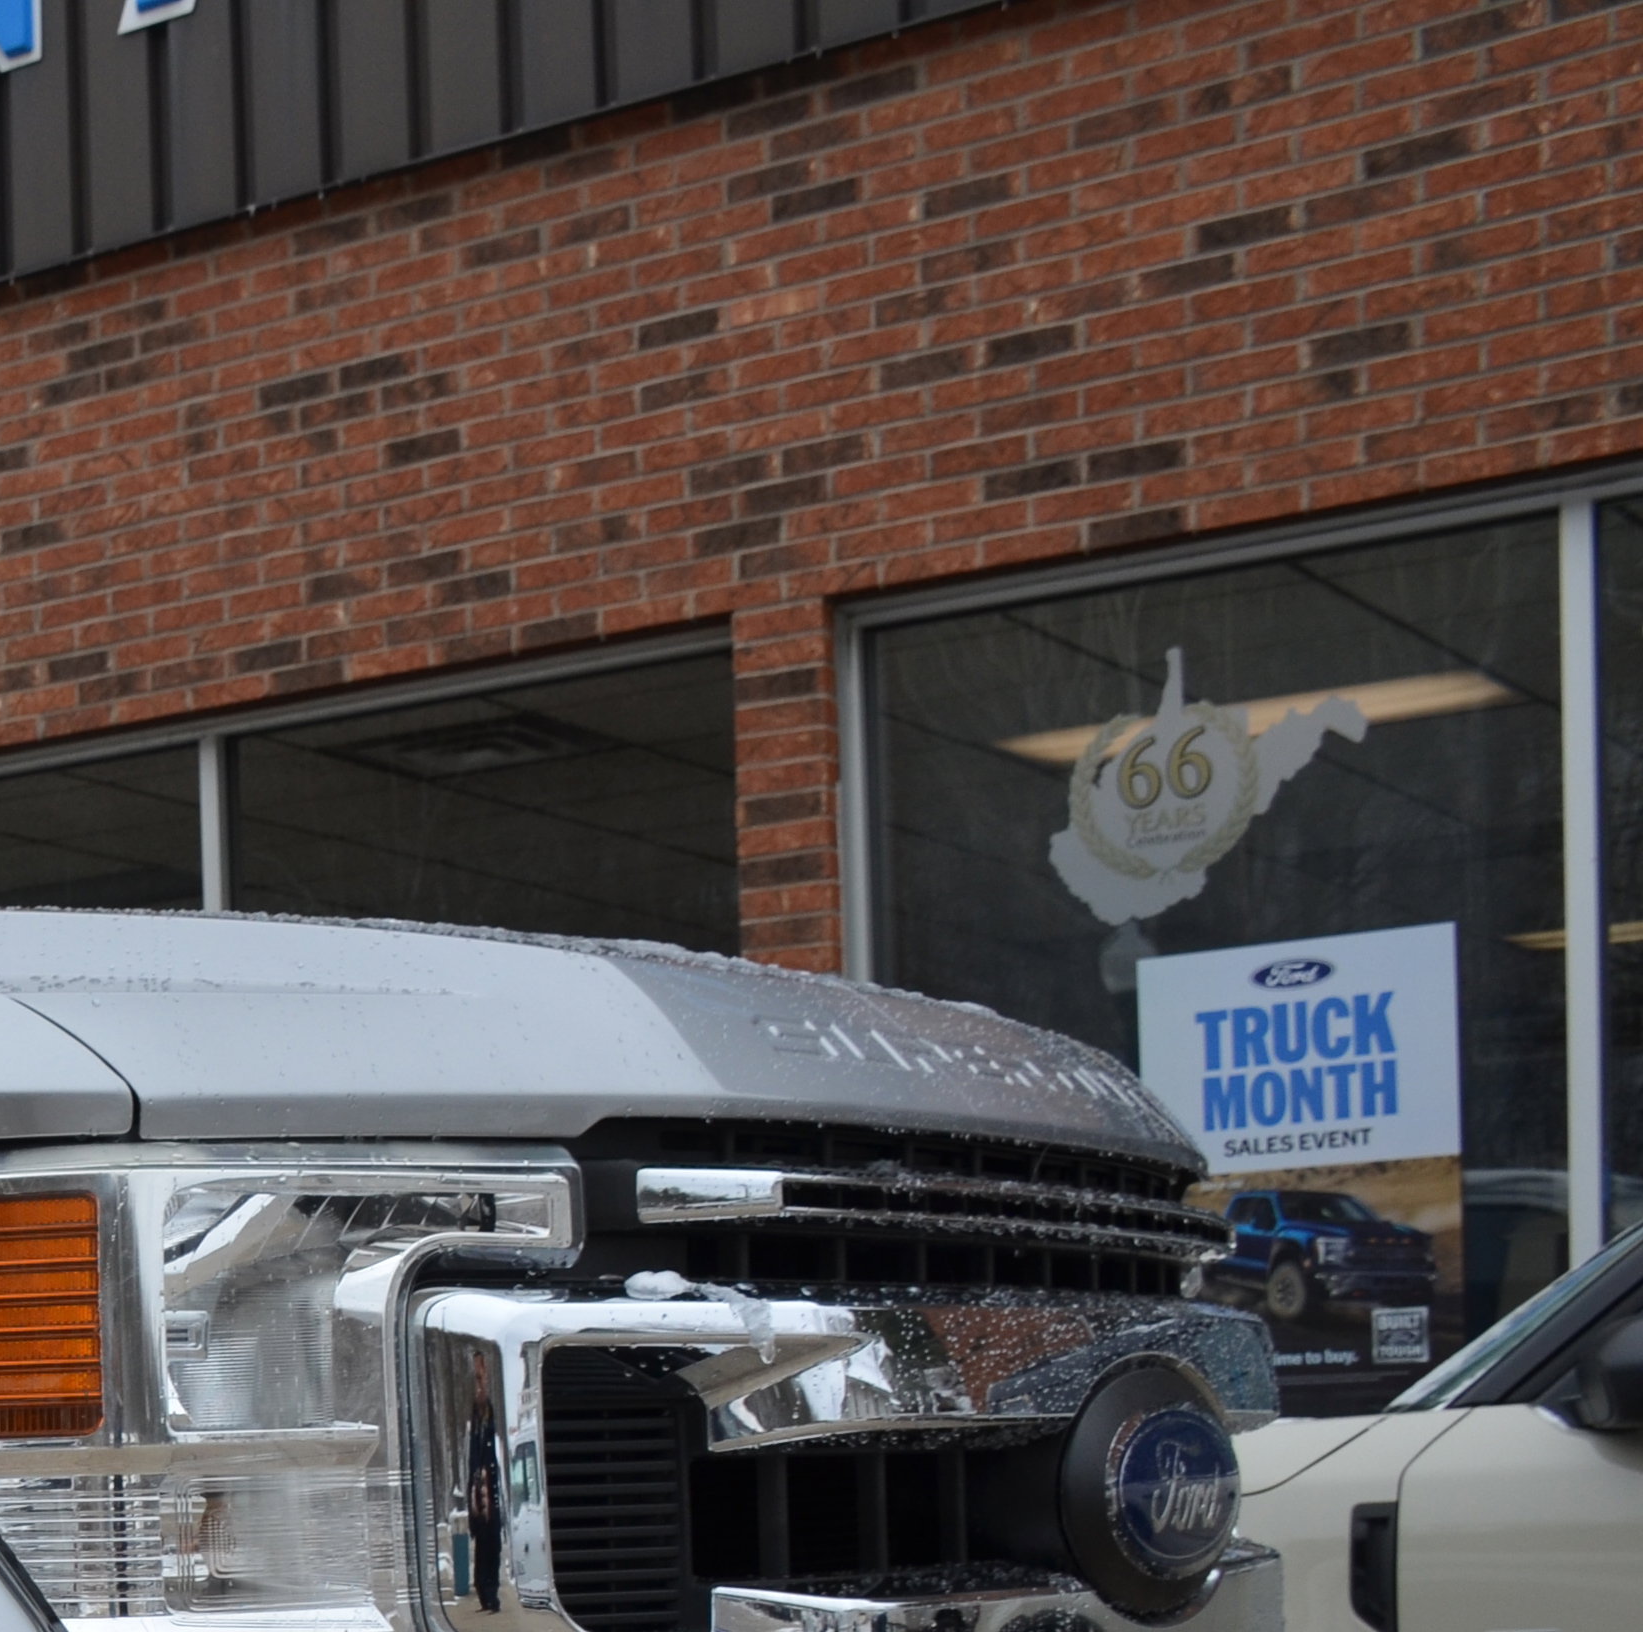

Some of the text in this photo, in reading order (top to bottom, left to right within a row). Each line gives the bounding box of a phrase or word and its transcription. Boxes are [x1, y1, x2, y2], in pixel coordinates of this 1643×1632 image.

[1117, 724, 1213, 810] 66
[1124, 803, 1207, 837] YEARS
[1266, 960, 1319, 988] Ford
[1195, 990, 1397, 1071] TRUCK
[1203, 1059, 1399, 1132] MONTH
[1224, 1128, 1373, 1158] SALES EVENT
[1272, 1352, 1303, 1367] ime
[1305, 1351, 1323, 1365] to
[1151, 1440, 1222, 1534] Ford
